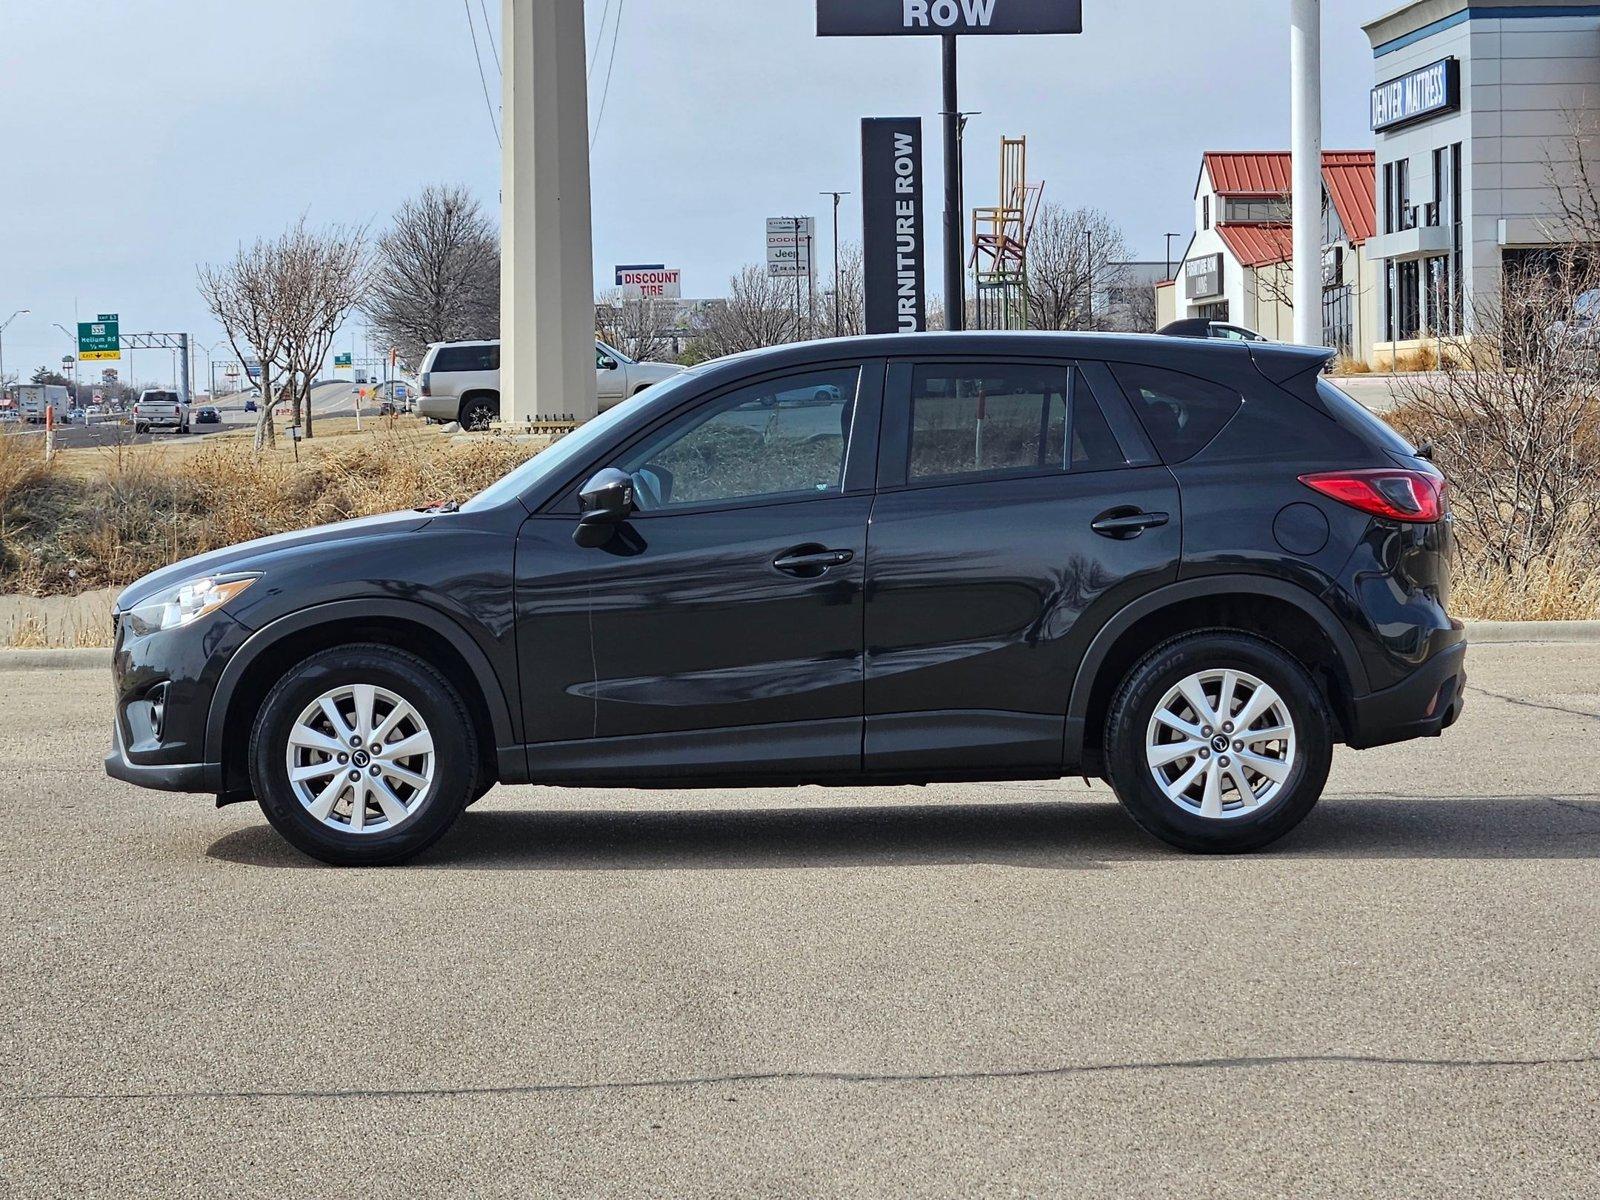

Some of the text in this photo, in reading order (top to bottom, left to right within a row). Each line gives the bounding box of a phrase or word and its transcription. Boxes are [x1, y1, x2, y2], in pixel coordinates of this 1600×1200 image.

[903, 0, 996, 27] ROW
[1372, 64, 1443, 127] DENVER MATTRESS
[893, 132, 914, 194] ROW
[625, 272, 678, 284] DISCOUNT
[640, 285, 663, 296] TIRE
